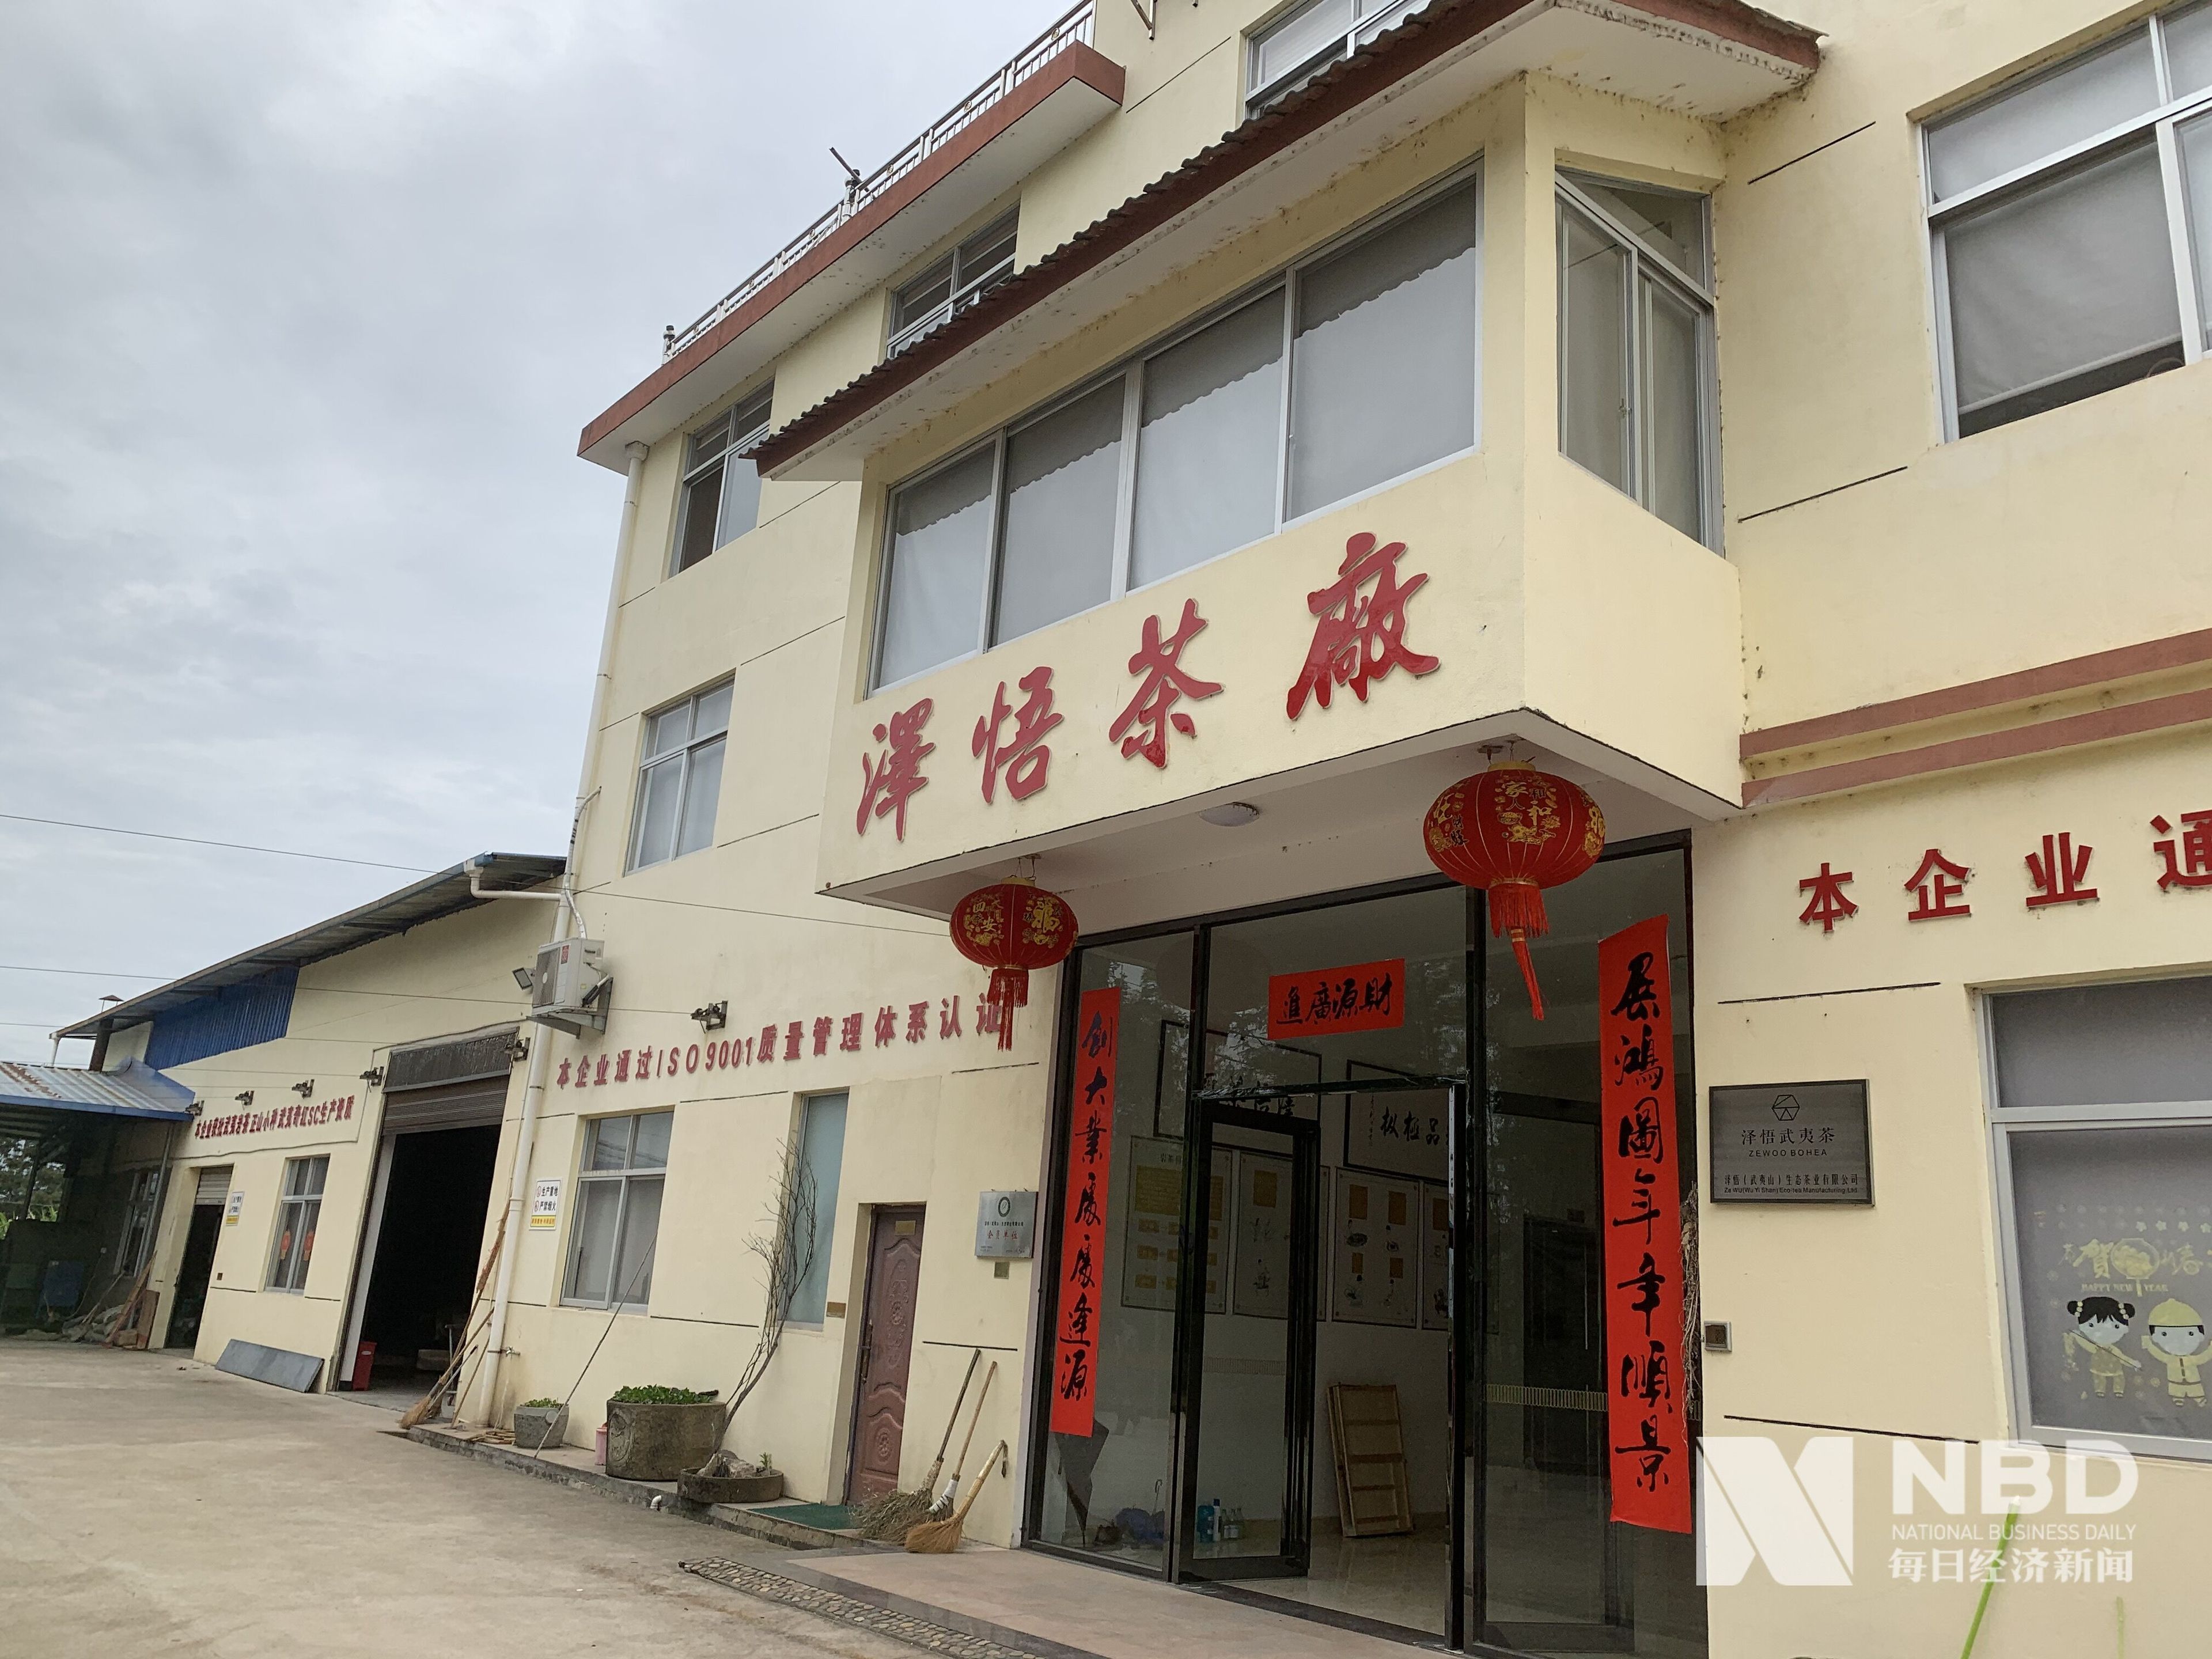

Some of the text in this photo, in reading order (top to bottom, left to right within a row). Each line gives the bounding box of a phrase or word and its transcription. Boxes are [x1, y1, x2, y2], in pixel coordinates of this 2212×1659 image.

[1798, 809, 2212, 932] 本企业通
[1741, 1127, 1835, 1145] 泽悟武夷茶
